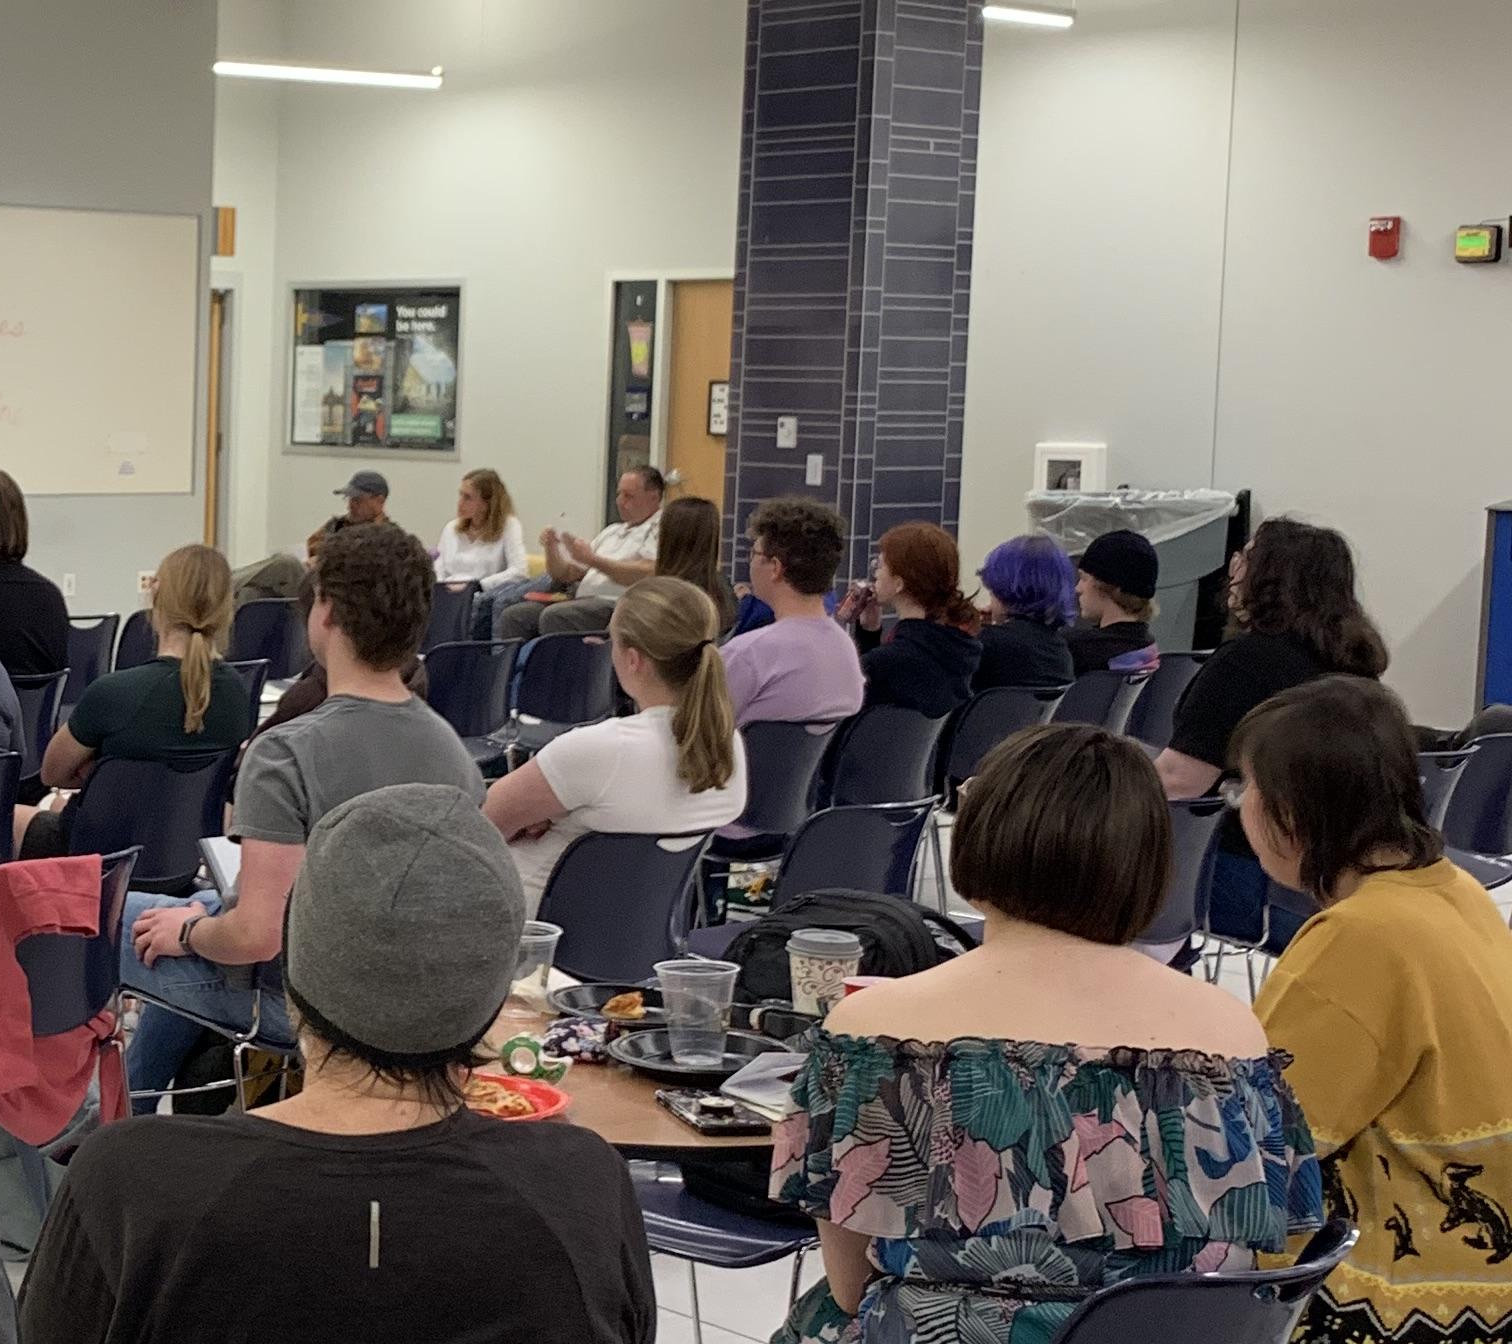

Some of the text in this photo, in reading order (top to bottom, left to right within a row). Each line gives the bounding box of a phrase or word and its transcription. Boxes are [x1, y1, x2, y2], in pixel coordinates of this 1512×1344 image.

[396, 305, 447, 318] You could
[396, 320, 409, 333] be
